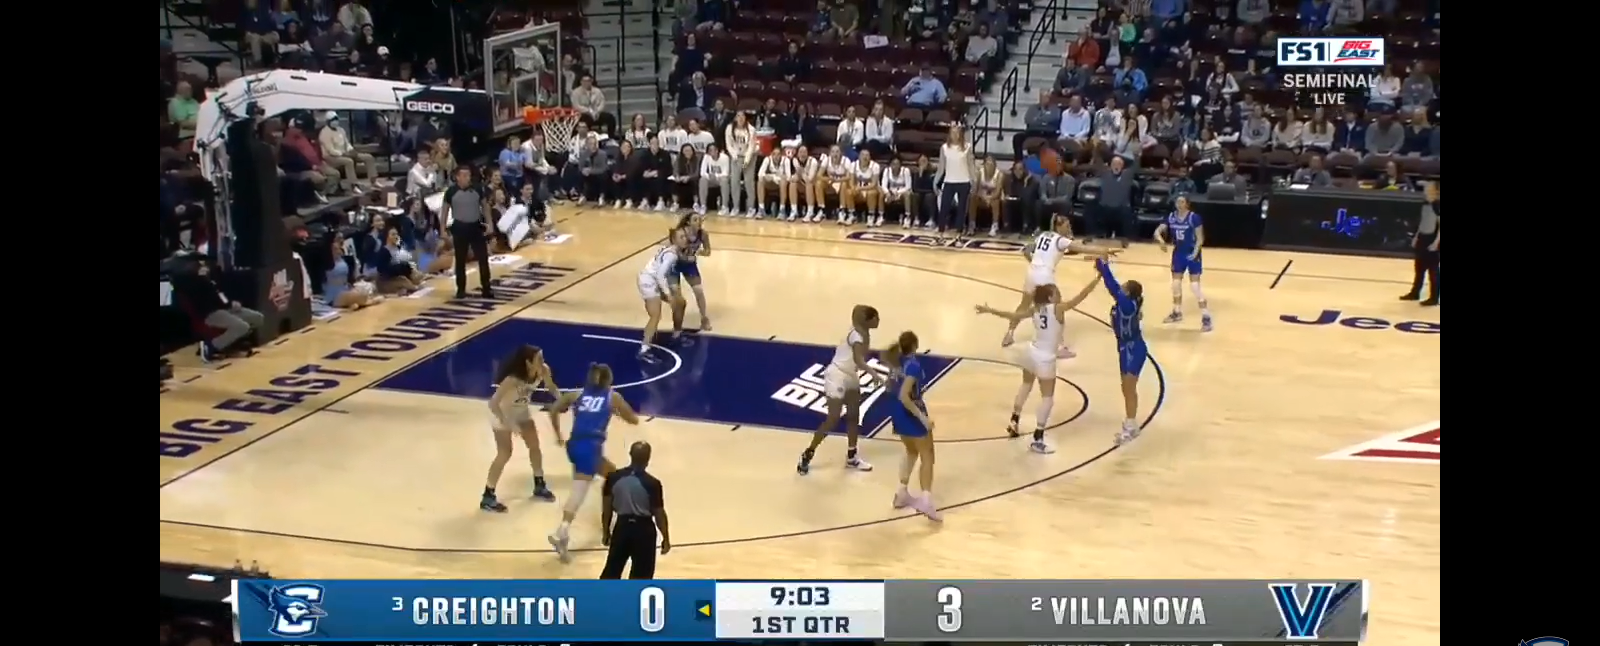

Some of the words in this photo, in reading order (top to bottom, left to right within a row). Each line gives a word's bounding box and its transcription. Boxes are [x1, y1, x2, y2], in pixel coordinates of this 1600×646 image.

[406, 100, 455, 115] GEICO
[845, 230, 1030, 252] GEIC
[1037, 237, 1052, 252] 15
[1039, 314, 1048, 330] 3
[160, 418, 257, 458] BIG
[212, 364, 361, 414] EAST
[322, 262, 577, 361] TOURNAMENT
[578, 395, 606, 412] 30
